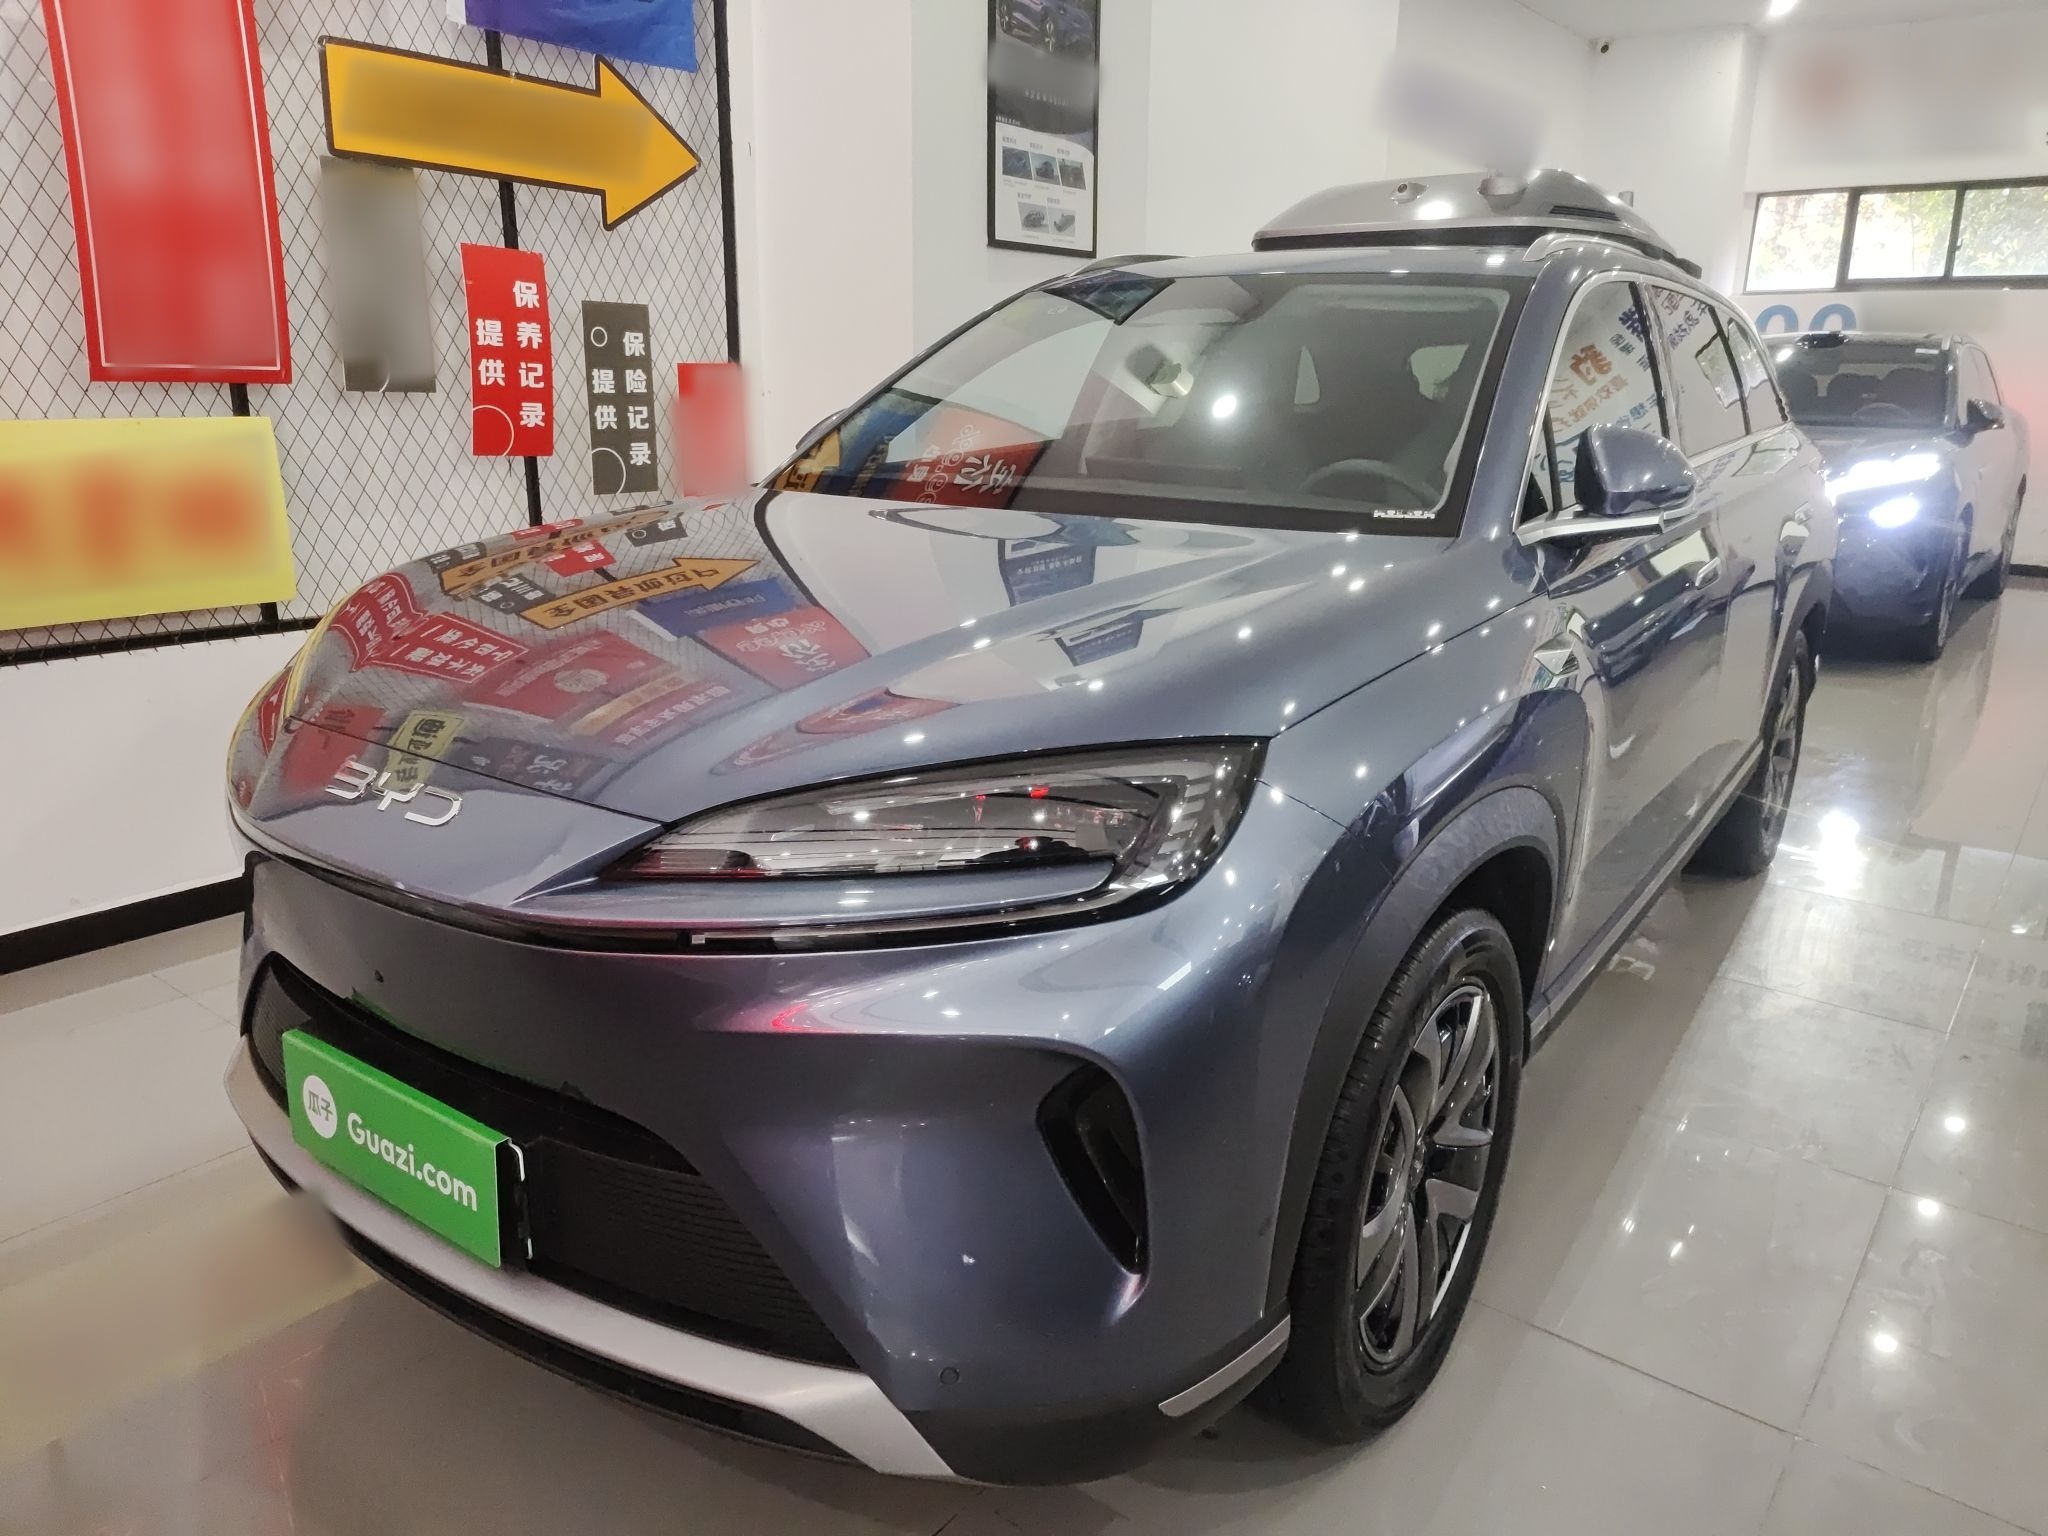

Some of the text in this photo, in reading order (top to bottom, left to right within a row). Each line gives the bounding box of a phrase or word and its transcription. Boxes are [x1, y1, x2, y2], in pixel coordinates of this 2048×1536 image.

[475, 318, 506, 387] 提供
[512, 280, 546, 428] 保养记录
[591, 368, 618, 430] 提供
[622, 331, 652, 466] 保险记录
[324, 760, 464, 827] BYD
[347, 1111, 478, 1212] Guazi.com
